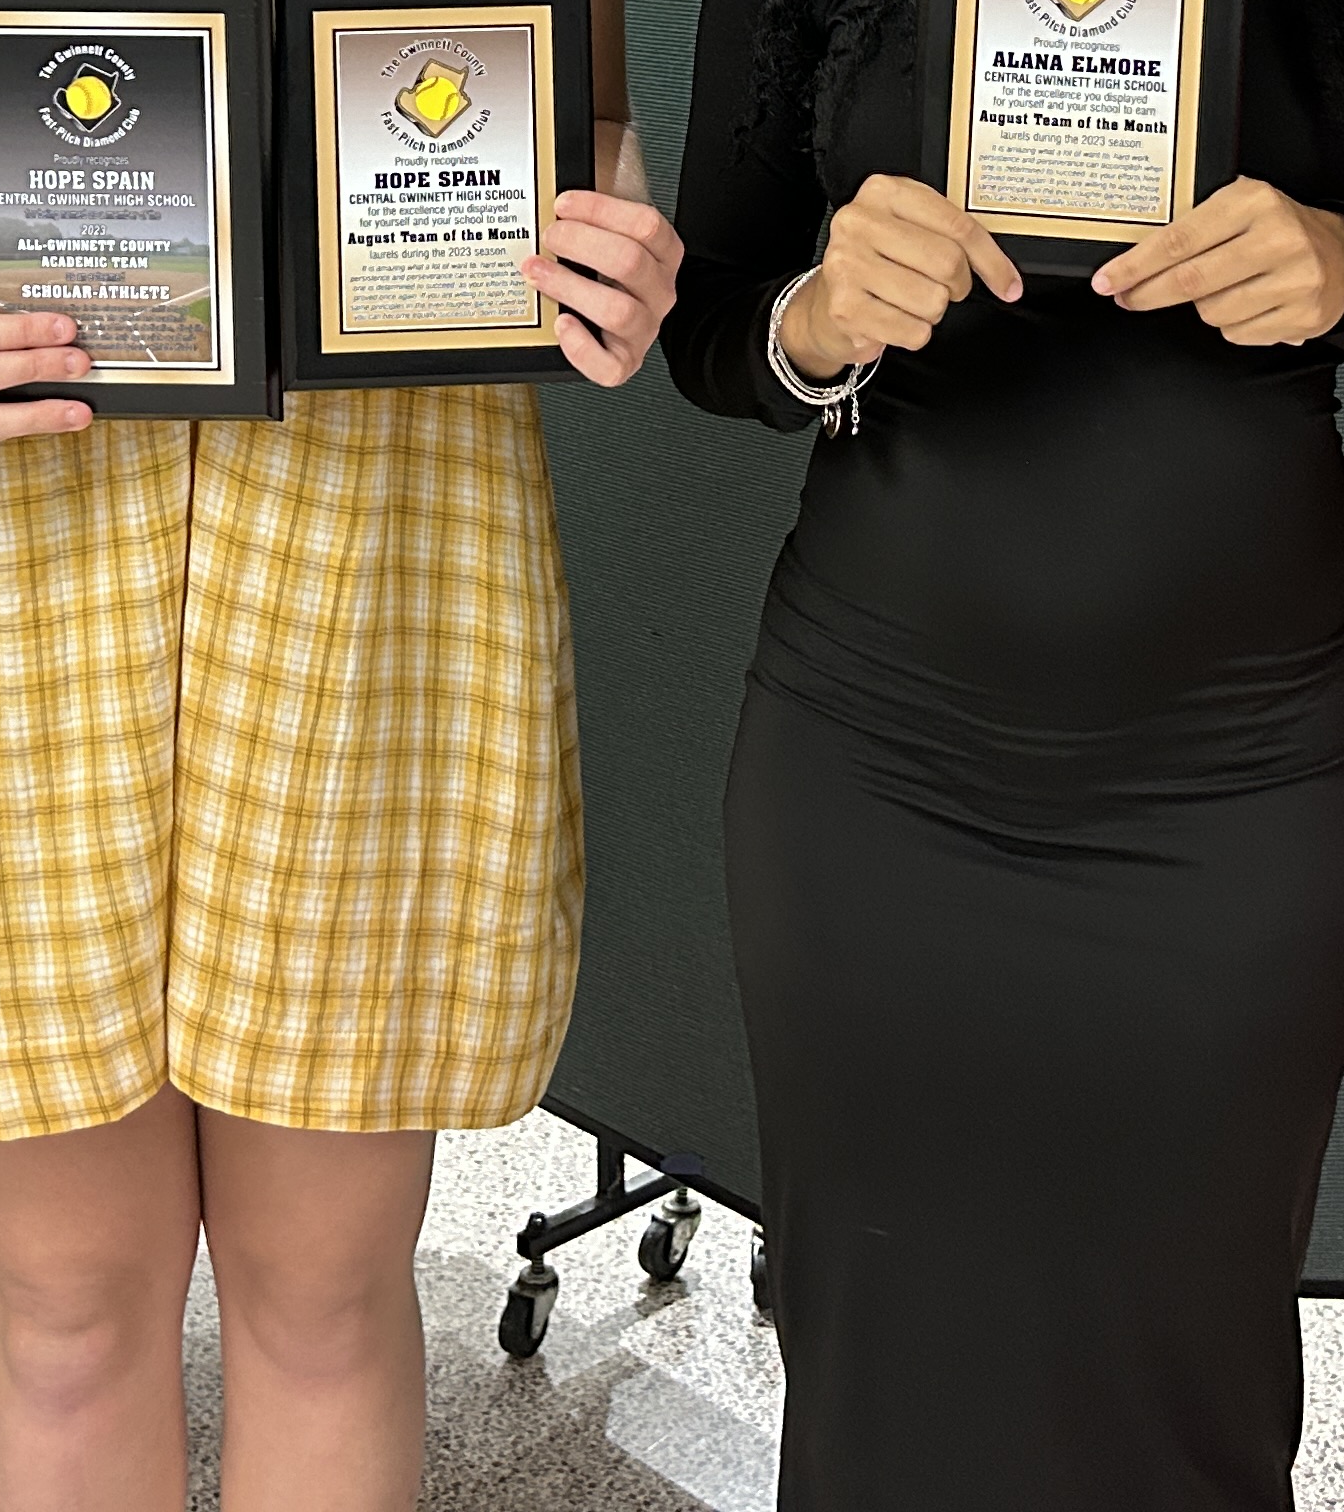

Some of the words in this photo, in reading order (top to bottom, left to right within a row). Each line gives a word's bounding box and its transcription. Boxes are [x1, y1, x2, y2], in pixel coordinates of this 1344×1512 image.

[1070, 16, 1118, 37] Diamond
[1033, 37, 1068, 50] Proudly
[1070, 40, 1120, 53] recognizes
[39, 61, 57, 78] The
[54, 45, 103, 62] Gwinnett
[105, 49, 136, 80] County
[381, 58, 399, 77] The
[399, 40, 450, 58] Gwinnett
[454, 43, 485, 76] County
[992, 50, 1063, 70] ALANA
[1071, 55, 1161, 77] ELMORE
[984, 71, 1031, 84] CENTRAL
[1035, 74, 1090, 87] GWINNETT
[1094, 77, 1120, 89] HIGH
[1123, 79, 1167, 92] SCHOOL
[1002, 86, 1014, 96] for
[1017, 87, 1031, 97] the
[1034, 88, 1081, 99] excellence
[1083, 93, 1101, 103] you
[1103, 92, 1147, 105] displayed
[992, 96, 1005, 106] for
[1007, 97, 1044, 110] yourself
[1047, 100, 1063, 109] and
[1066, 103, 1086, 113] your
[1089, 102, 1120, 112] school
[1123, 104, 1132, 113] to
[1135, 107, 1155, 115] earn
[38, 107, 80, 145] Fast-Pitch
[84, 127, 125, 146] Diamond
[121, 109, 140, 130] Club
[979, 109, 1028, 127] August
[1033, 113, 1071, 127] Team
[1077, 116, 1091, 128] of
[1096, 117, 1118, 130] the
[1123, 119, 1167, 133] Month
[380, 111, 424, 151] Fast-Pitch
[428, 130, 474, 153] Diamond
[472, 110, 490, 132] Club
[1000, 130, 1030, 141] laurels
[1032, 132, 1061, 145] during
[1064, 134, 1078, 144] the
[1081, 135, 1105, 145] 2023
[394, 156, 427, 167] Proudly
[430, 156, 478, 166] recognizes
[28, 170, 85, 189] HOPE
[92, 170, 154, 190] SPAIN
[374, 171, 430, 188] HOPE
[438, 169, 500, 187] SPAIN
[47, 193, 110, 205] GWINNETT
[113, 193, 143, 205] HIGH
[147, 194, 195, 206] SCHOOL
[349, 192, 395, 204] CENTRAL
[399, 191, 452, 202] GWINNETT
[456, 190, 480, 201] HIGH
[484, 189, 526, 200] SCHOOL
[367, 206, 380, 215] for
[382, 206, 395, 215] the
[399, 205, 445, 215] excellence
[447, 206, 463, 215] you
[466, 203, 508, 215] displayed
[80, 224, 107, 235] 2023
[347, 231, 395, 246] August
[400, 230, 437, 243] Team
[443, 229, 455, 241] of
[461, 228, 482, 241] the
[488, 227, 529, 240] Month
[17, 238, 115, 251] ALL-GWINNETT
[119, 239, 170, 251] COUNTY
[40, 256, 107, 268] ACADEMIC
[111, 256, 148, 268] TEAM
[21, 284, 169, 299] SCHOLAR-ATHLETE
